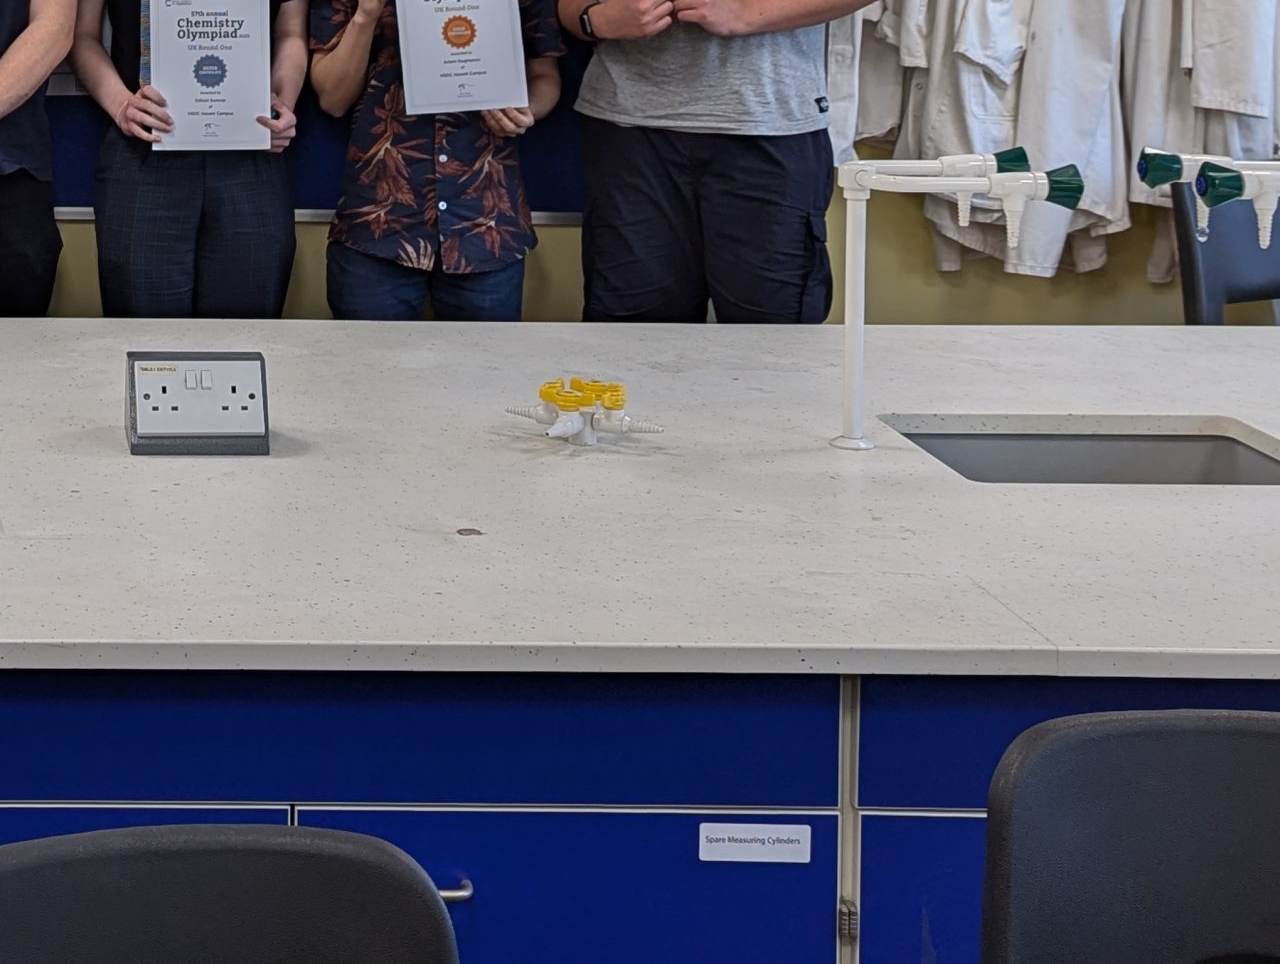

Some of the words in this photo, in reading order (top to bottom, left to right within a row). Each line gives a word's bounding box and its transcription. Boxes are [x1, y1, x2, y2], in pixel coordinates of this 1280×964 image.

[177, 18, 245, 32] Chemistry
[177, 28, 239, 43] Olympiad
[705, 835, 727, 844] Spare
[727, 835, 766, 846] Measuring
[767, 836, 801, 846] Cylinders
